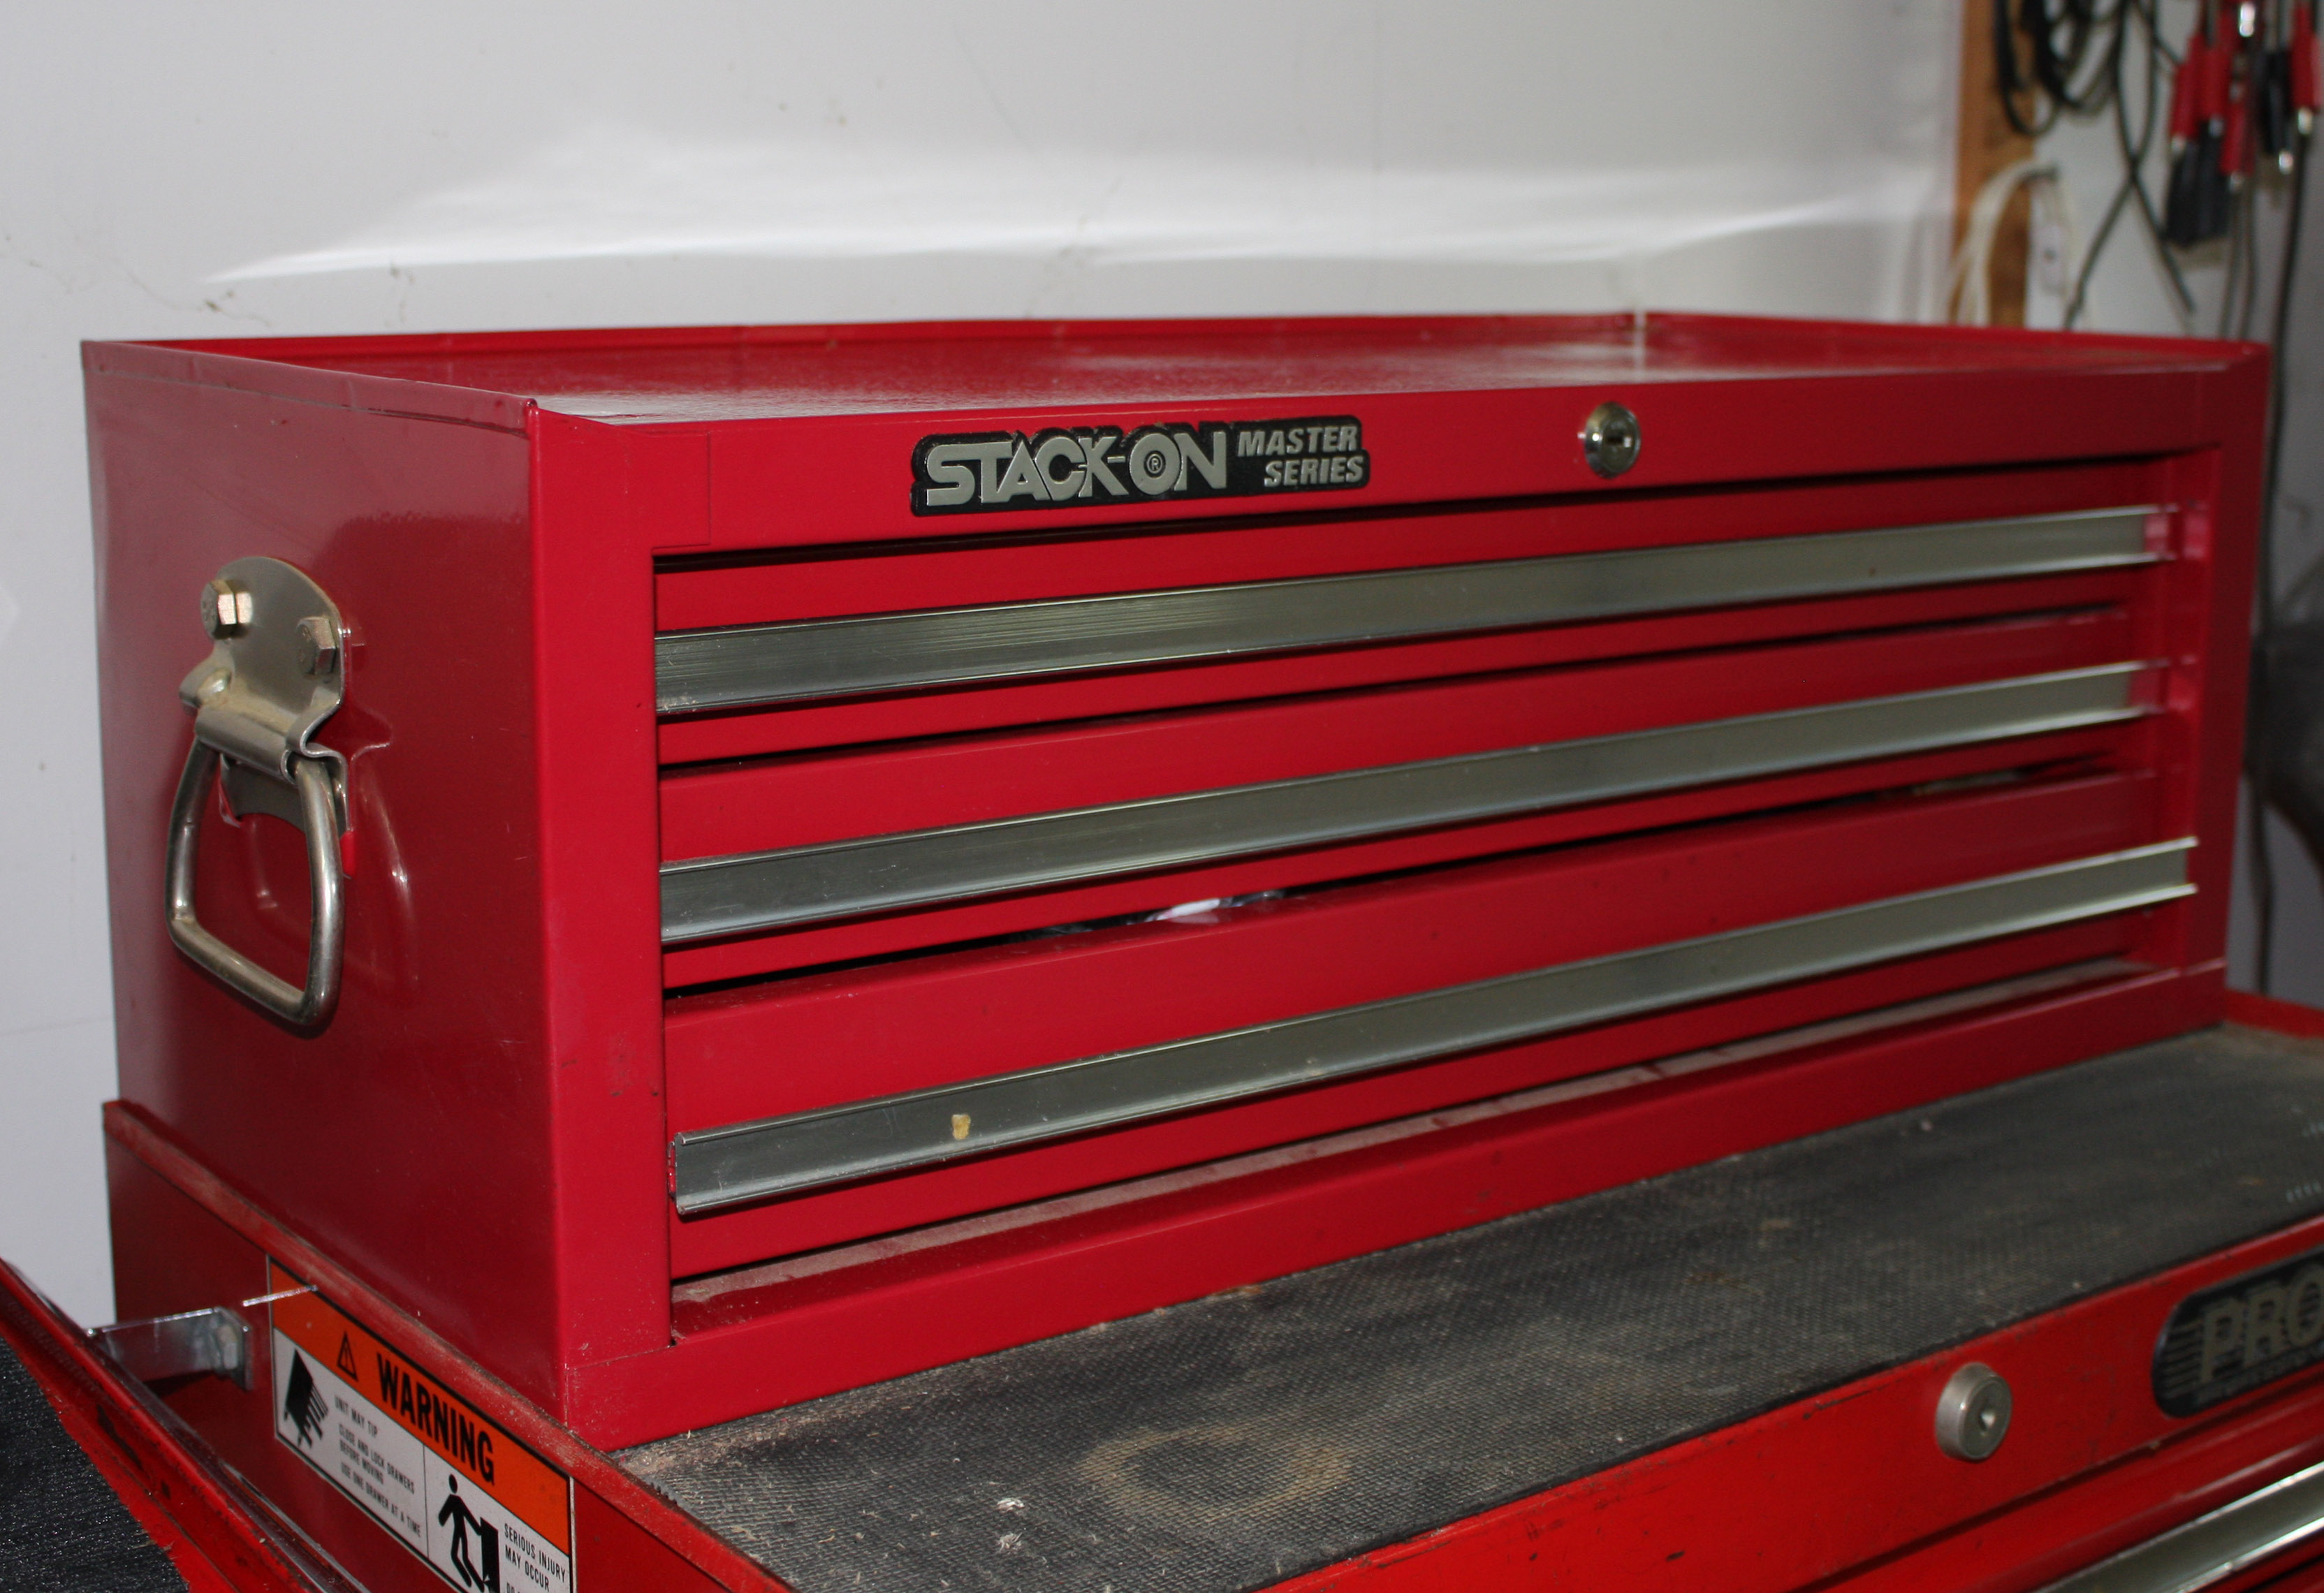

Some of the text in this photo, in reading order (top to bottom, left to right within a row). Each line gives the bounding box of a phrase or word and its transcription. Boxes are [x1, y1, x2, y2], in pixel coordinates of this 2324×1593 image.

[926, 425, 1358, 507] STACK-ON MASTER
[1264, 455, 1364, 487] SERIES
[335, 1394, 378, 1438] UNIT MAY TIP
[377, 1352, 495, 1486] WARNING
[339, 1439, 384, 1485] BEFORE MOVING
[357, 1439, 369, 1457] AND
[370, 1450, 385, 1469] LOCK
[386, 1462, 415, 1495] DRAWERS
[340, 1461, 351, 1479] USE
[352, 1470, 364, 1490] ONE
[365, 1481, 389, 1510] DRAWER
[390, 1502, 398, 1518] AT
[406, 1515, 421, 1538] TIME
[504, 1522, 565, 1583] SERIOUS INJURY
[505, 1544, 550, 1593] MAY OCCUR
